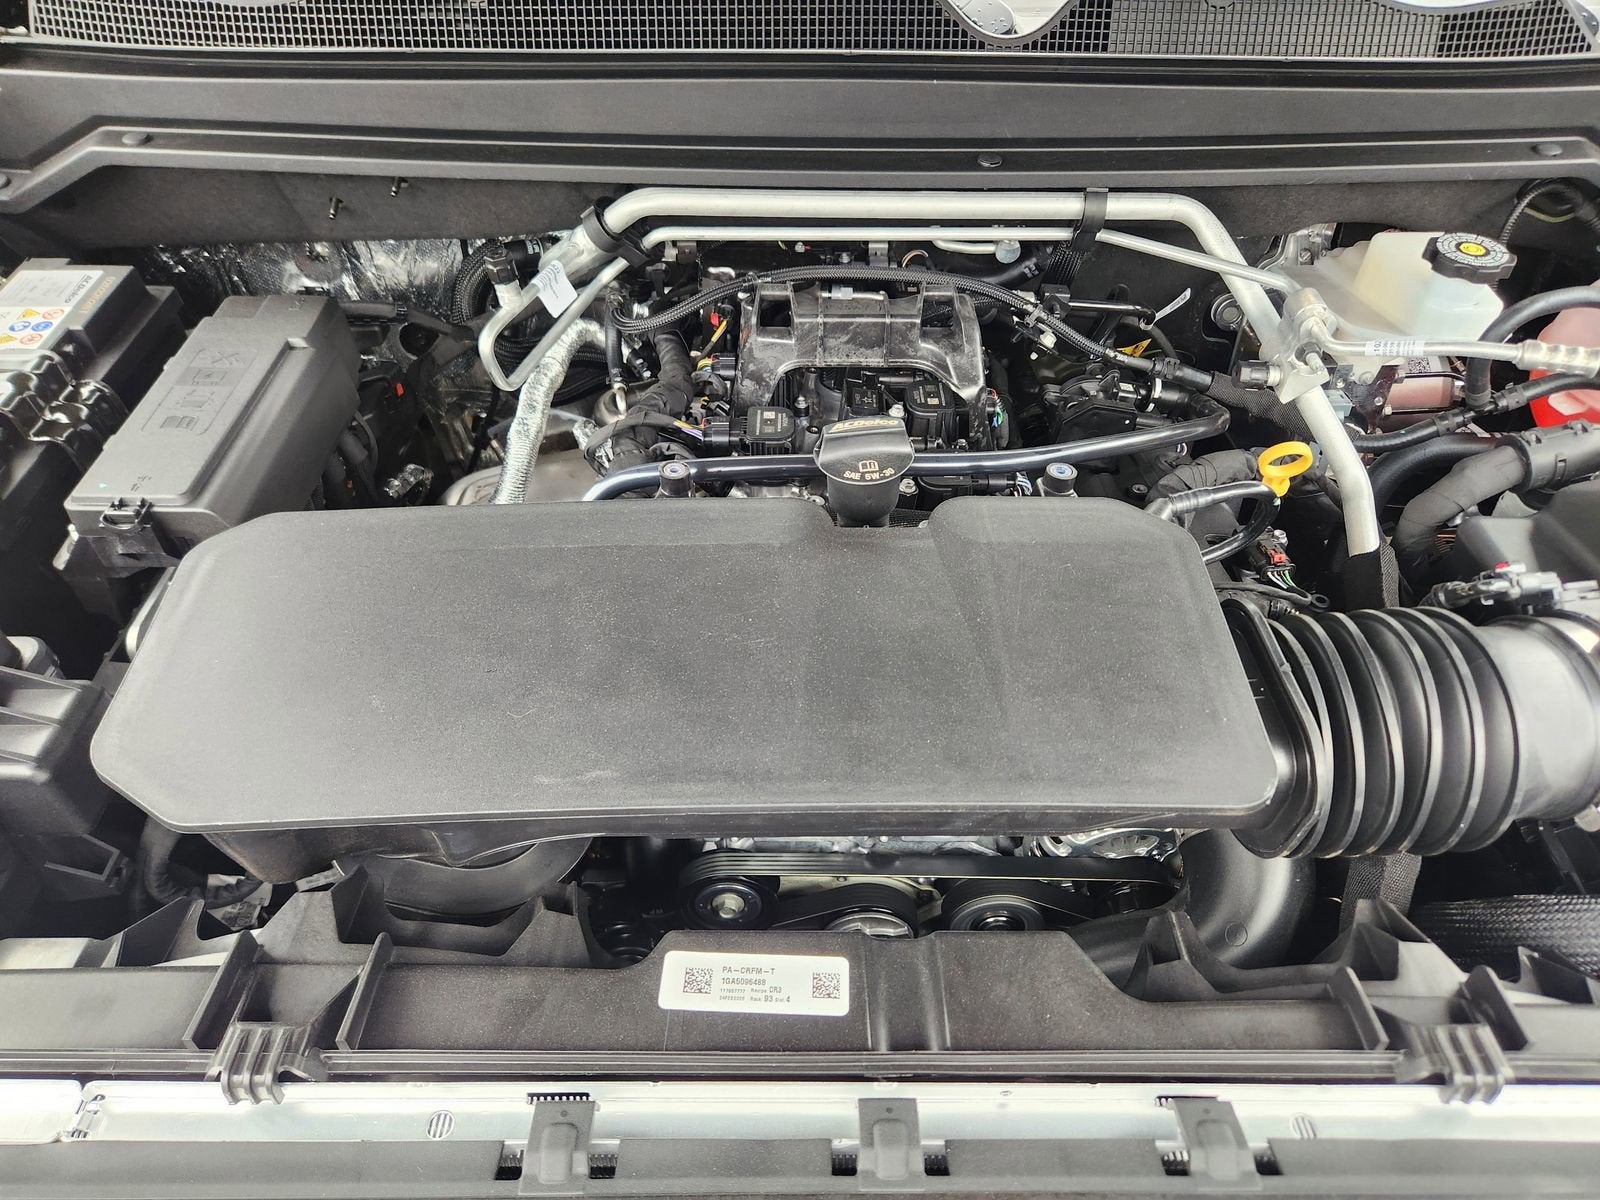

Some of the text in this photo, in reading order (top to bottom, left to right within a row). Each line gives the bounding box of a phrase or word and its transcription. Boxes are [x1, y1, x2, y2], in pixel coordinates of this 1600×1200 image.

[829, 419, 899, 433] ACDelco
[843, 467, 895, 481] SAE 5W-30
[722, 966, 776, 976] PA-CRFM-T
[764, 995, 773, 1003] 93
[786, 995, 791, 1003] 4
